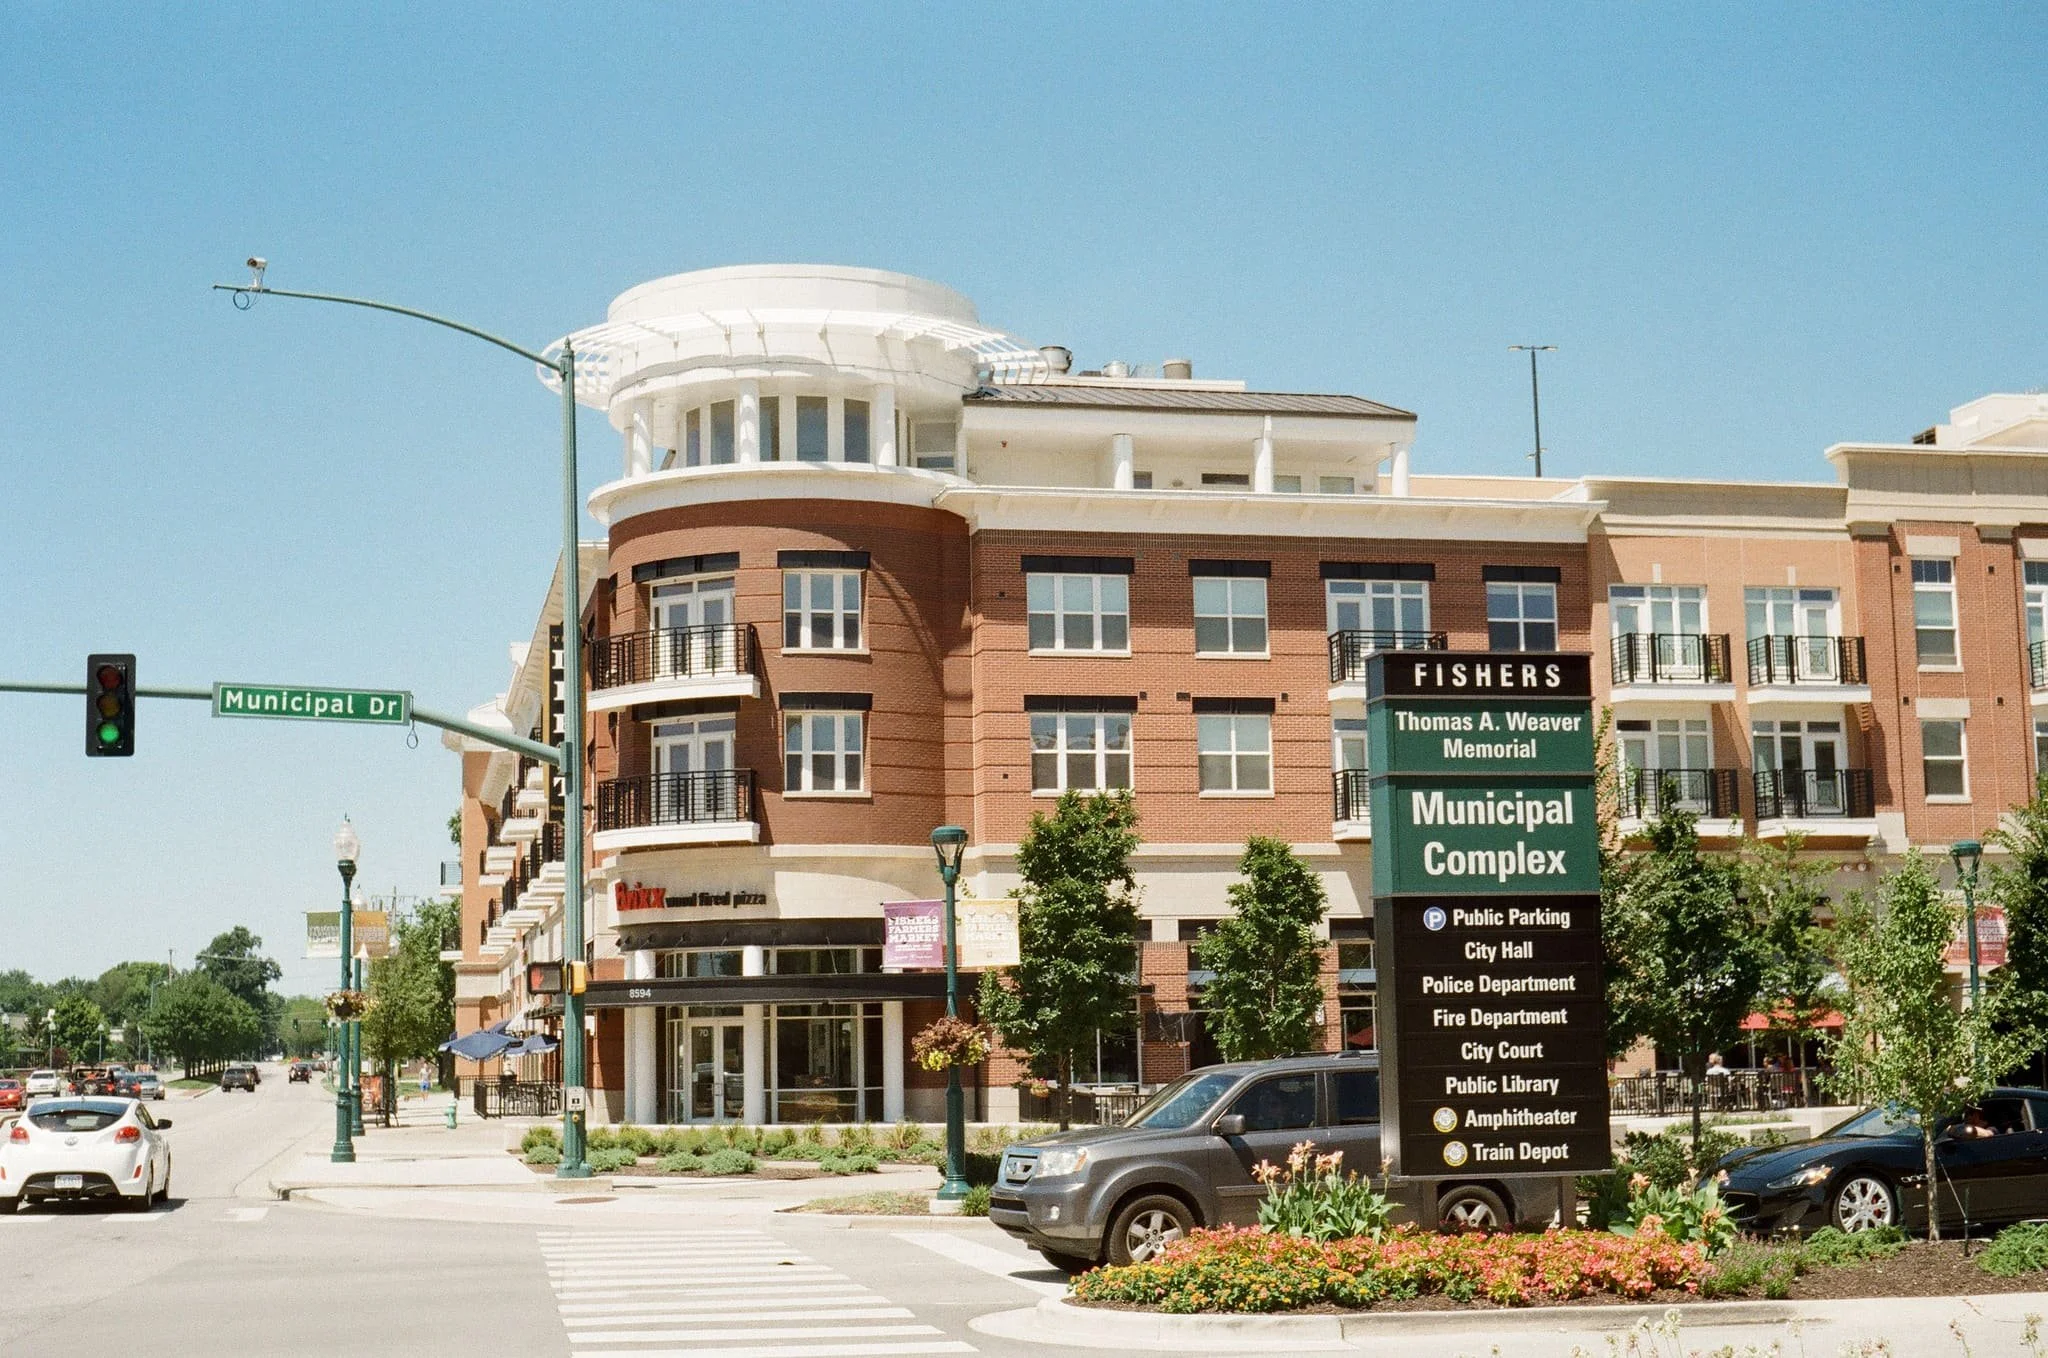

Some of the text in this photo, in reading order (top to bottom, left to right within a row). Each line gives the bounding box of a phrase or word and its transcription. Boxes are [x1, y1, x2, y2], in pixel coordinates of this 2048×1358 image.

[1414, 663, 1561, 688] FISHERS
[225, 690, 397, 717] Municipal Dr
[1395, 711, 1582, 732] Thomas A. Weaver
[1443, 738, 1537, 759] Memorial
[1411, 791, 1574, 833] Municipal
[1423, 840, 1568, 883] Complex
[699, 891, 731, 907] fired
[733, 890, 767, 909] pizza
[888, 925, 939, 934] FARMERS
[1452, 908, 1505, 927] Public
[1508, 907, 1571, 929] Parking
[1464, 940, 1534, 963] City Hall
[628, 988, 652, 999] 8594
[1422, 974, 1576, 997] Police Department
[1433, 1007, 1569, 1030] Fire Department
[1461, 1040, 1544, 1064] City Court
[1445, 1074, 1560, 1096] Public Library
[1464, 1108, 1578, 1131] Amphitheater
[1471, 1142, 1569, 1164] Train Depot
